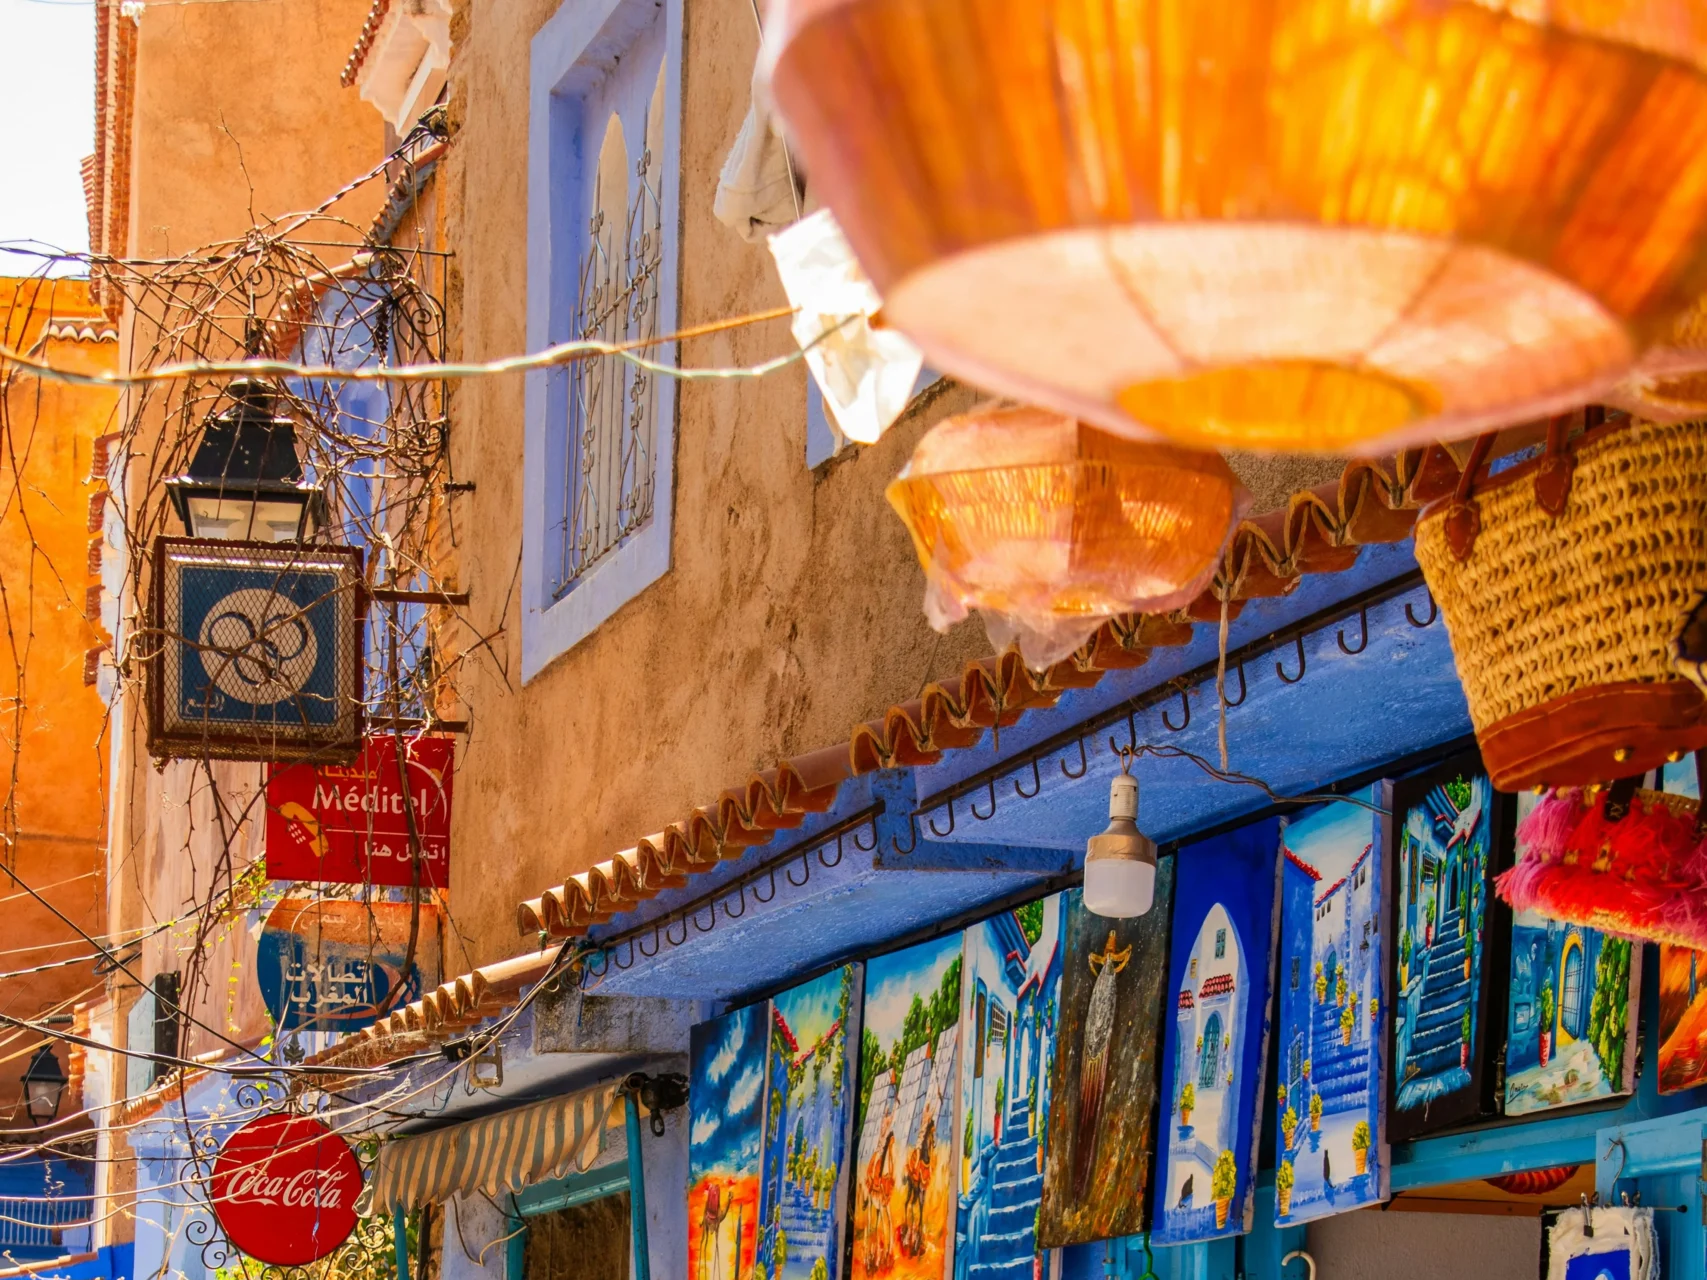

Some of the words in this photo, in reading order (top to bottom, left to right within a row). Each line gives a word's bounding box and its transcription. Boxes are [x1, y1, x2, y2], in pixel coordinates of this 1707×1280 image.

[311, 783, 428, 816] Méditel
[364, 840, 392, 857] هنا
[285, 960, 374, 984] اتصالات
[290, 985, 368, 1009] المغرب
[225, 1167, 349, 1209] Coca-Cola
